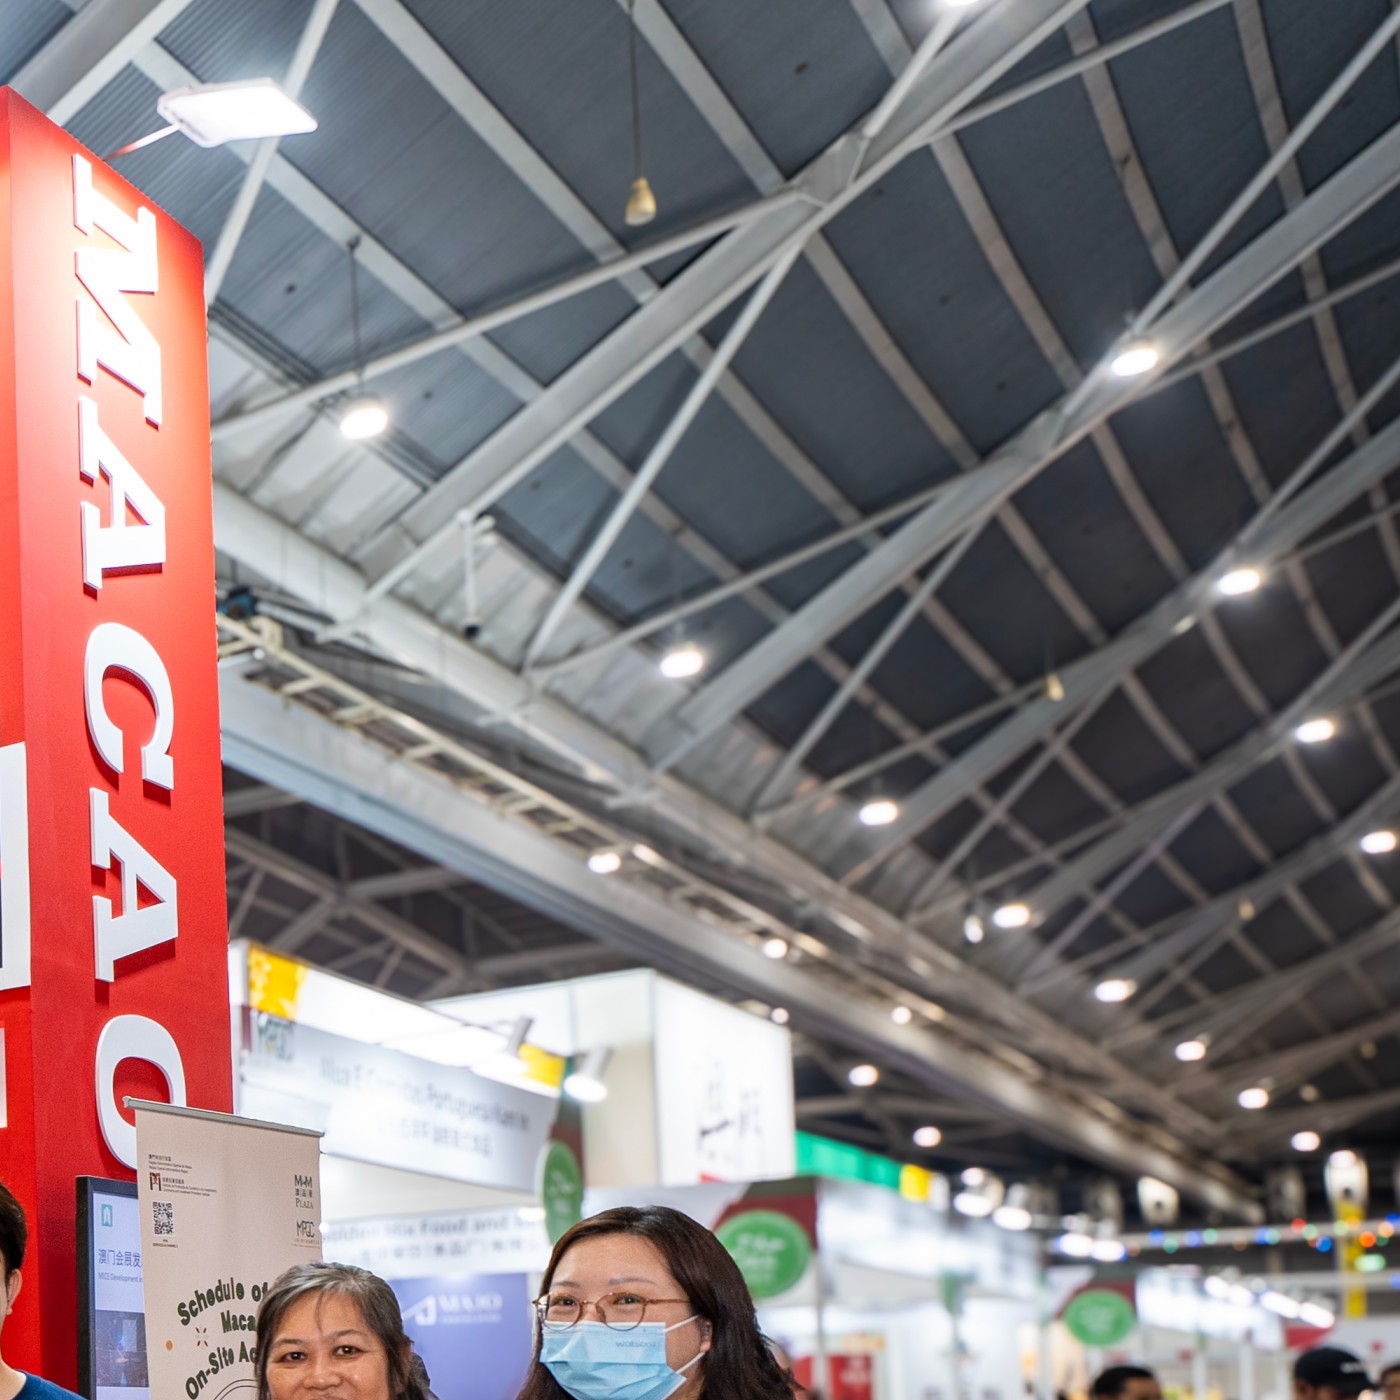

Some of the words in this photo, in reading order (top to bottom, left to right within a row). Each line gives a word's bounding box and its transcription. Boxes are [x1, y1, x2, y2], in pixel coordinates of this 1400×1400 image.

[72, 152, 187, 1170] MACAO
[98, 1249, 142, 1268] 澳门会展发
[177, 1277, 245, 1326] Schedule
[221, 1310, 256, 1334] Maca
[186, 1341, 235, 1400] On-Site
